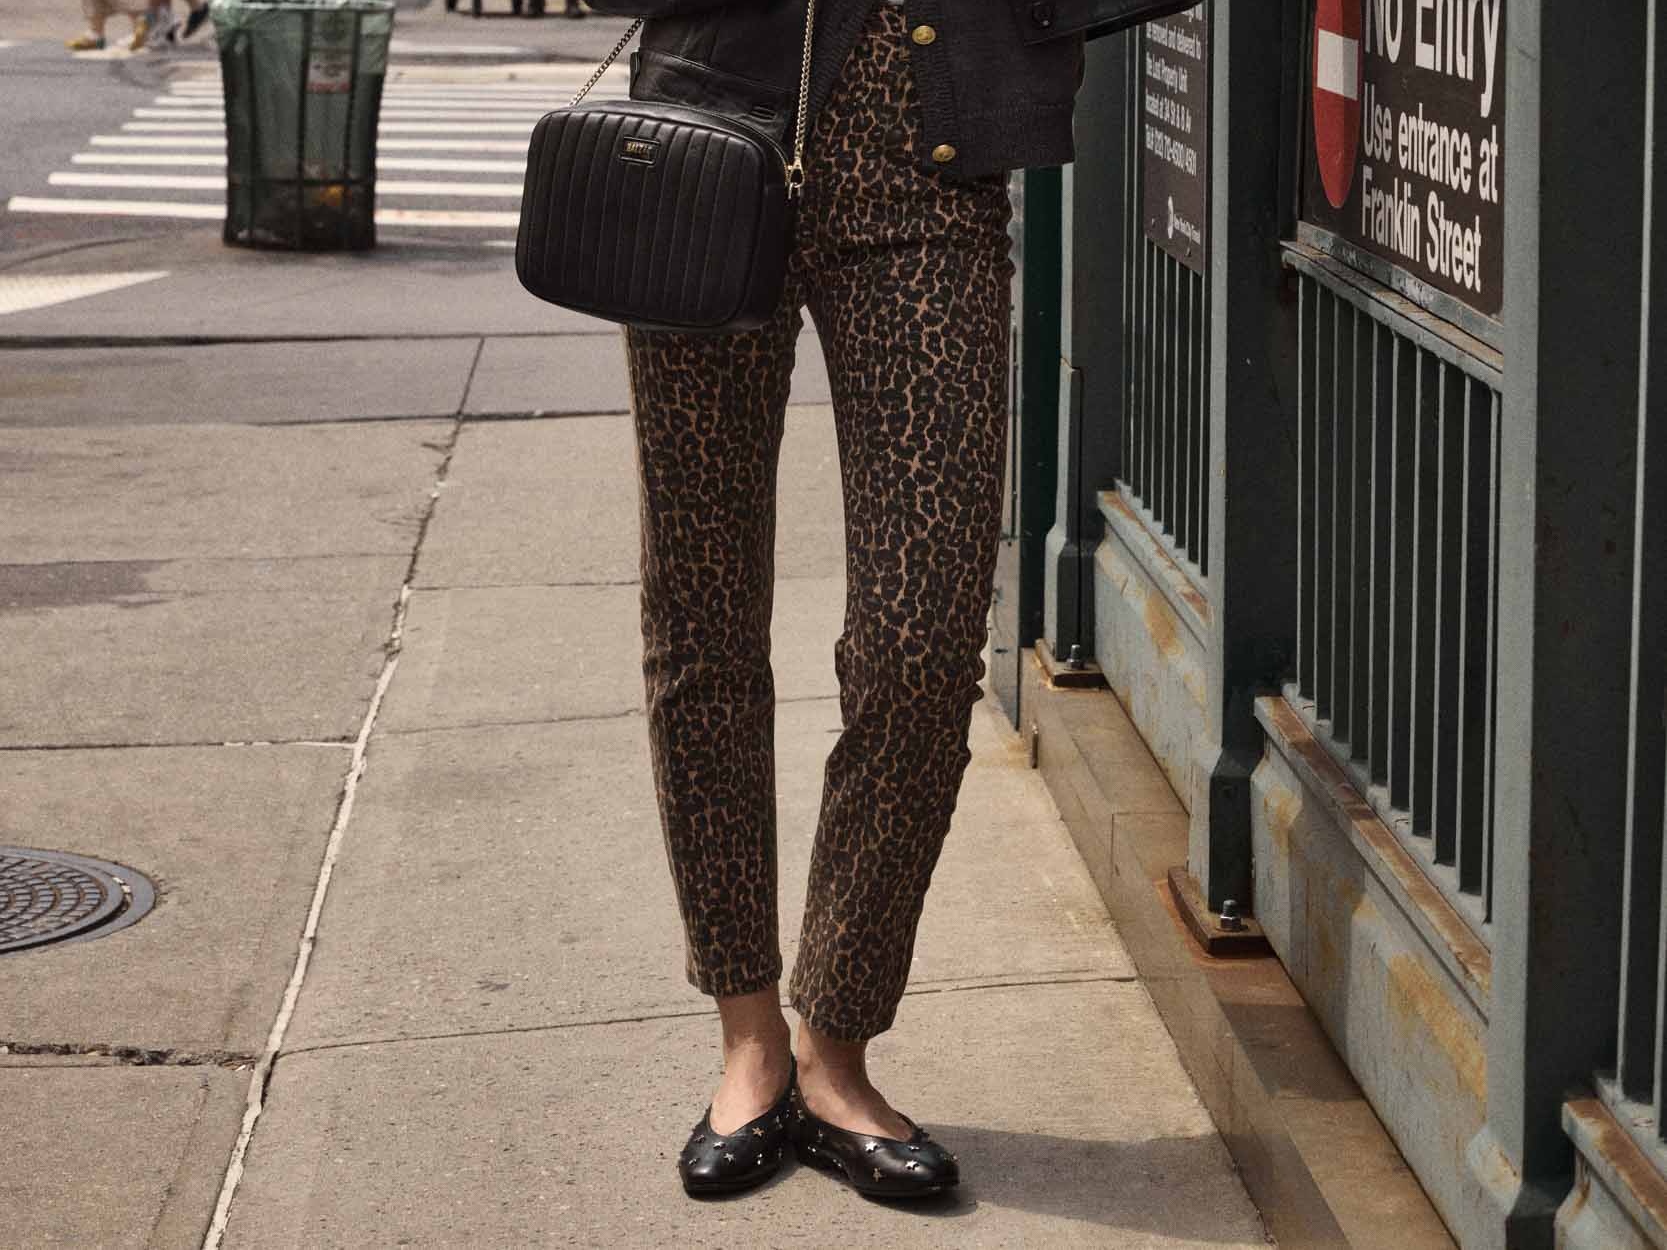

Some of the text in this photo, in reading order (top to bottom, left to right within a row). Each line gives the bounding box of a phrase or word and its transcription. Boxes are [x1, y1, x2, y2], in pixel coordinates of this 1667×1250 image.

[1363, 82, 1499, 204] Use entrance at
[1362, 164, 1482, 294] Franklin Street
